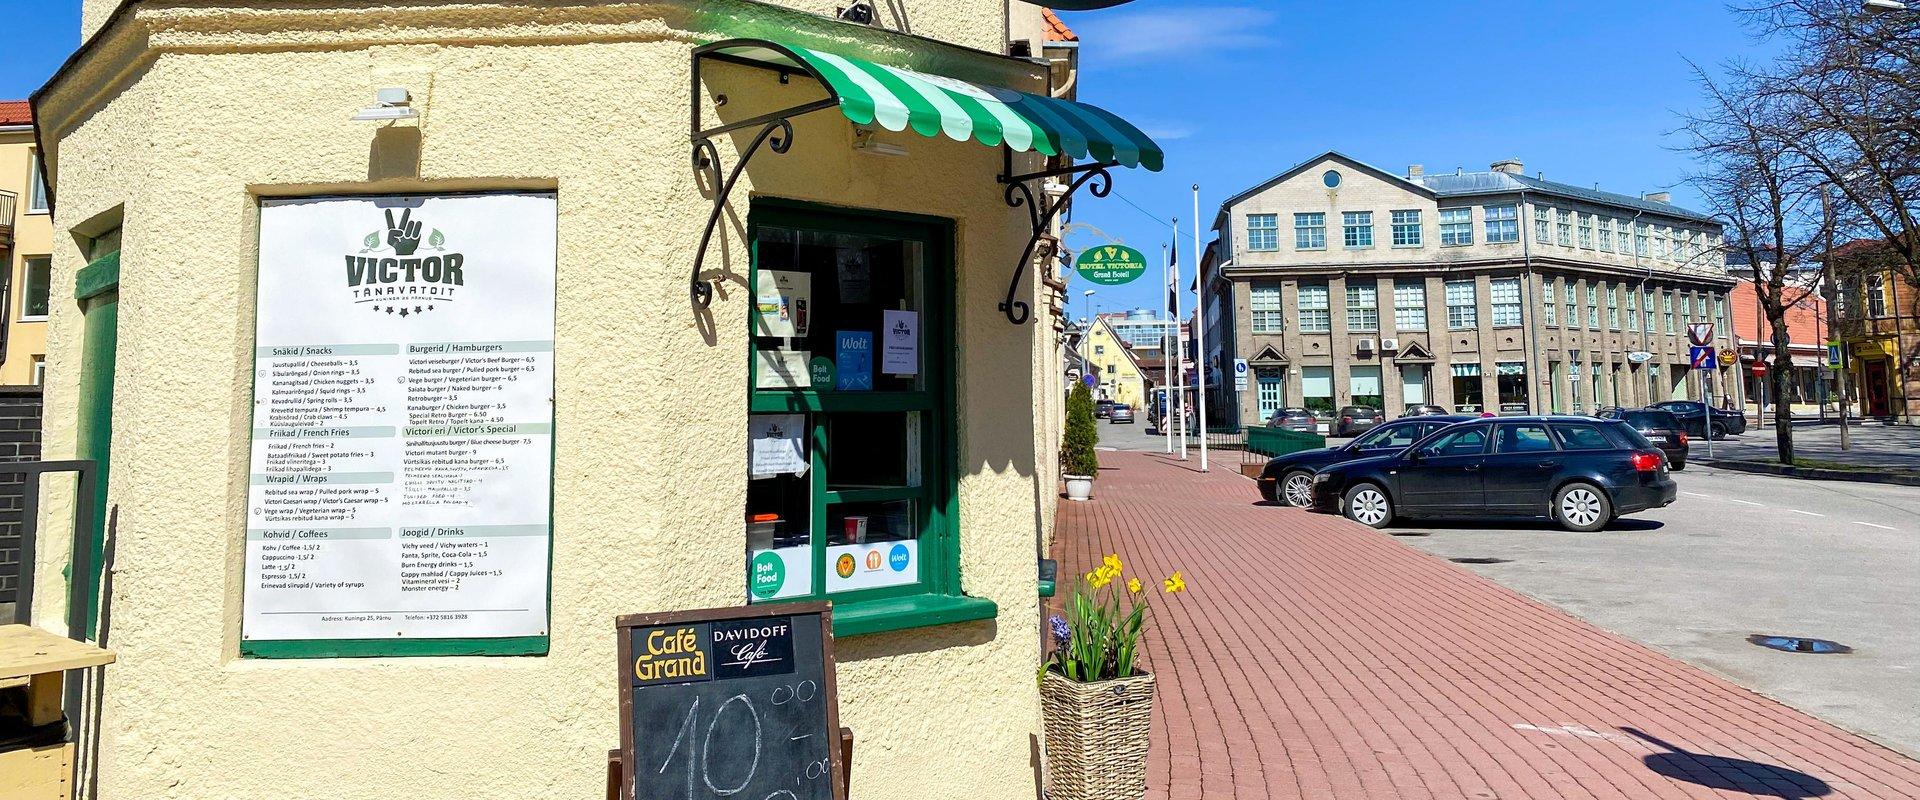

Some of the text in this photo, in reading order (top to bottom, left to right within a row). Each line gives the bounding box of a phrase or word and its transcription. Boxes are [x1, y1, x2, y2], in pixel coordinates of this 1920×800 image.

[345, 253, 464, 287] VICTOR
[354, 286, 455, 298] TÄNAVATOIT
[842, 337, 867, 350] Wolt
[410, 346, 443, 354] Burgerid
[813, 365, 827, 375] Bolt
[813, 375, 830, 383] Food
[487, 425, 516, 433] Special
[403, 529, 428, 538] Joogid
[891, 553, 907, 562] Wolt
[757, 563, 773, 574] Bolt
[757, 573, 777, 584] Food
[714, 625, 788, 642] DAVIDOFF
[647, 627, 697, 656] Café
[731, 640, 768, 669] Café
[635, 651, 706, 681] Grand
[660, 694, 762, 800] 10
